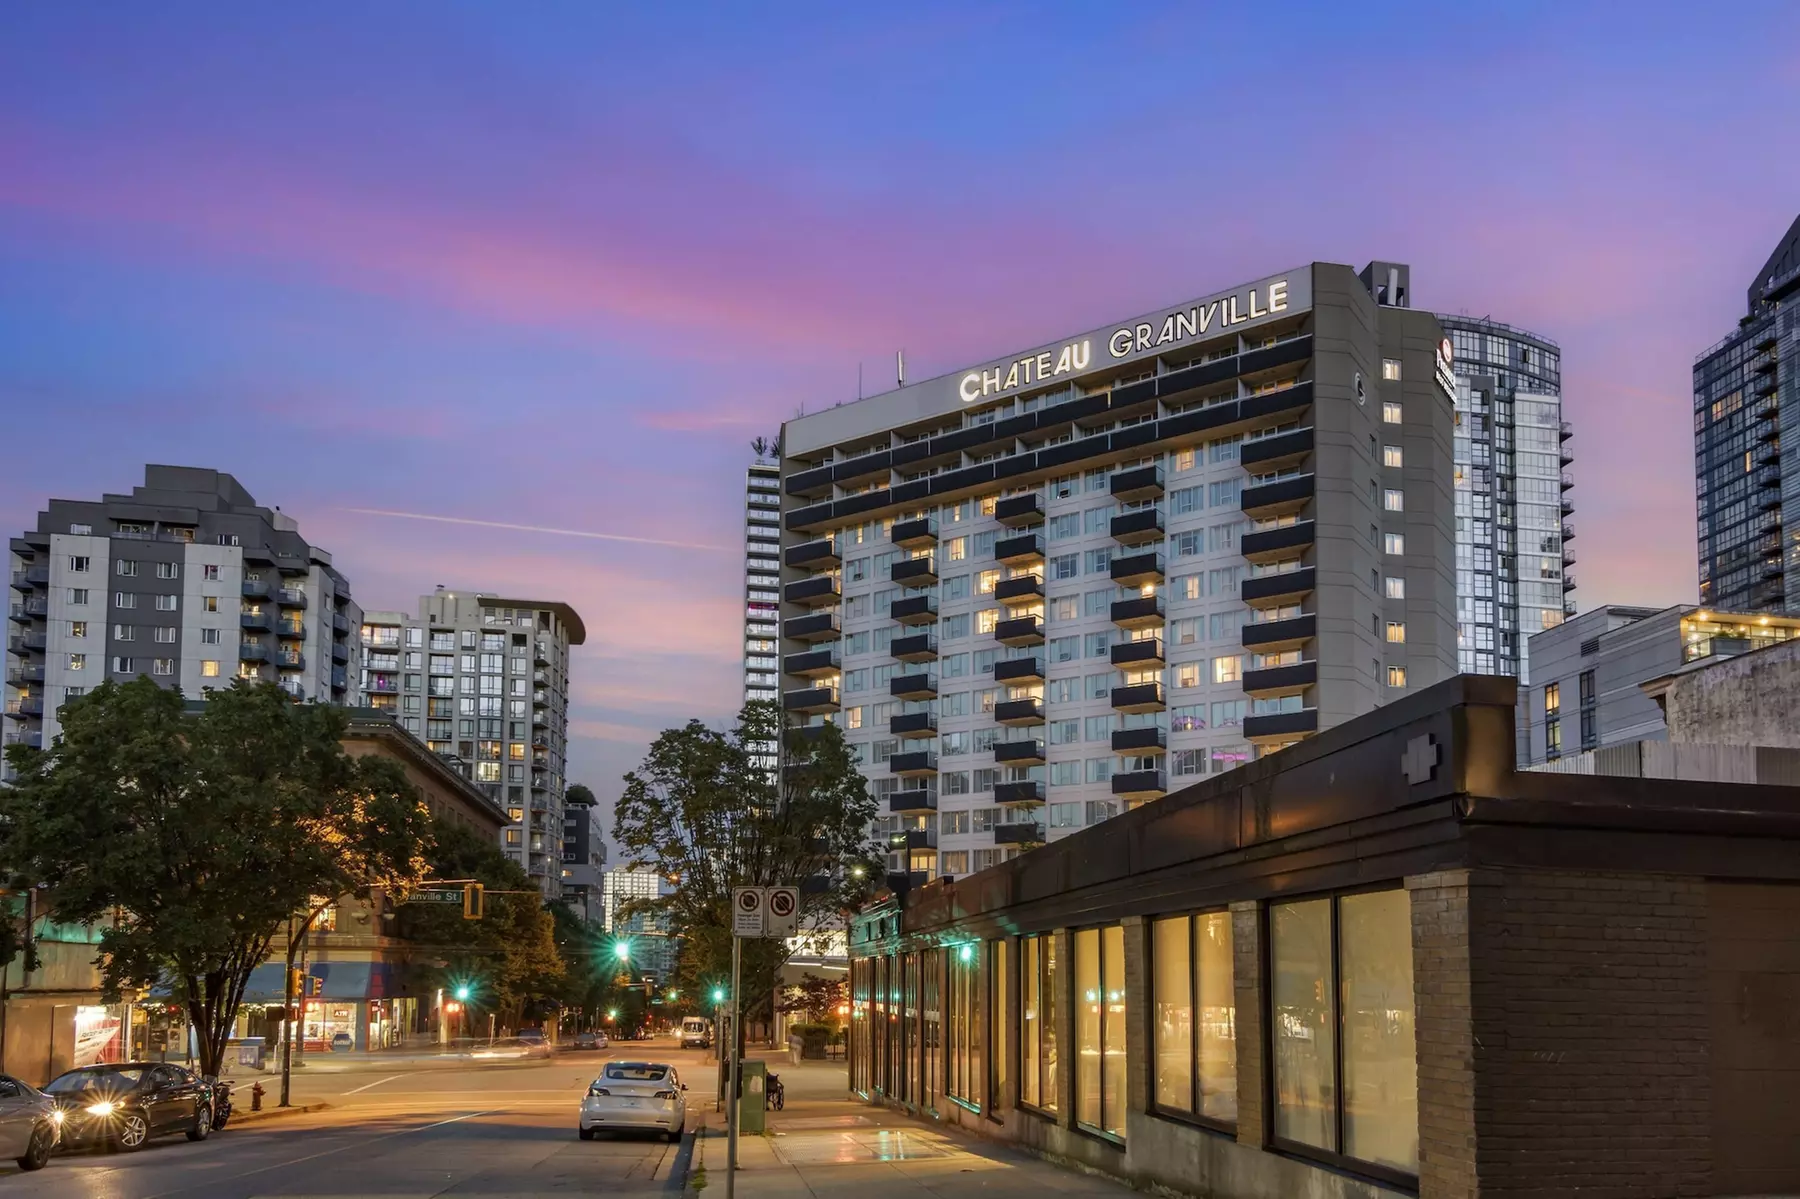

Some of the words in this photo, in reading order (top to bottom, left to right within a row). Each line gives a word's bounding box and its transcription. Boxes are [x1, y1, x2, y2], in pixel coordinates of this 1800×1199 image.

[958, 339, 1091, 402] CHATEAU
[1108, 279, 1289, 359] GRANVILLE
[407, 892, 442, 901] anville
[445, 892, 457, 901] St
